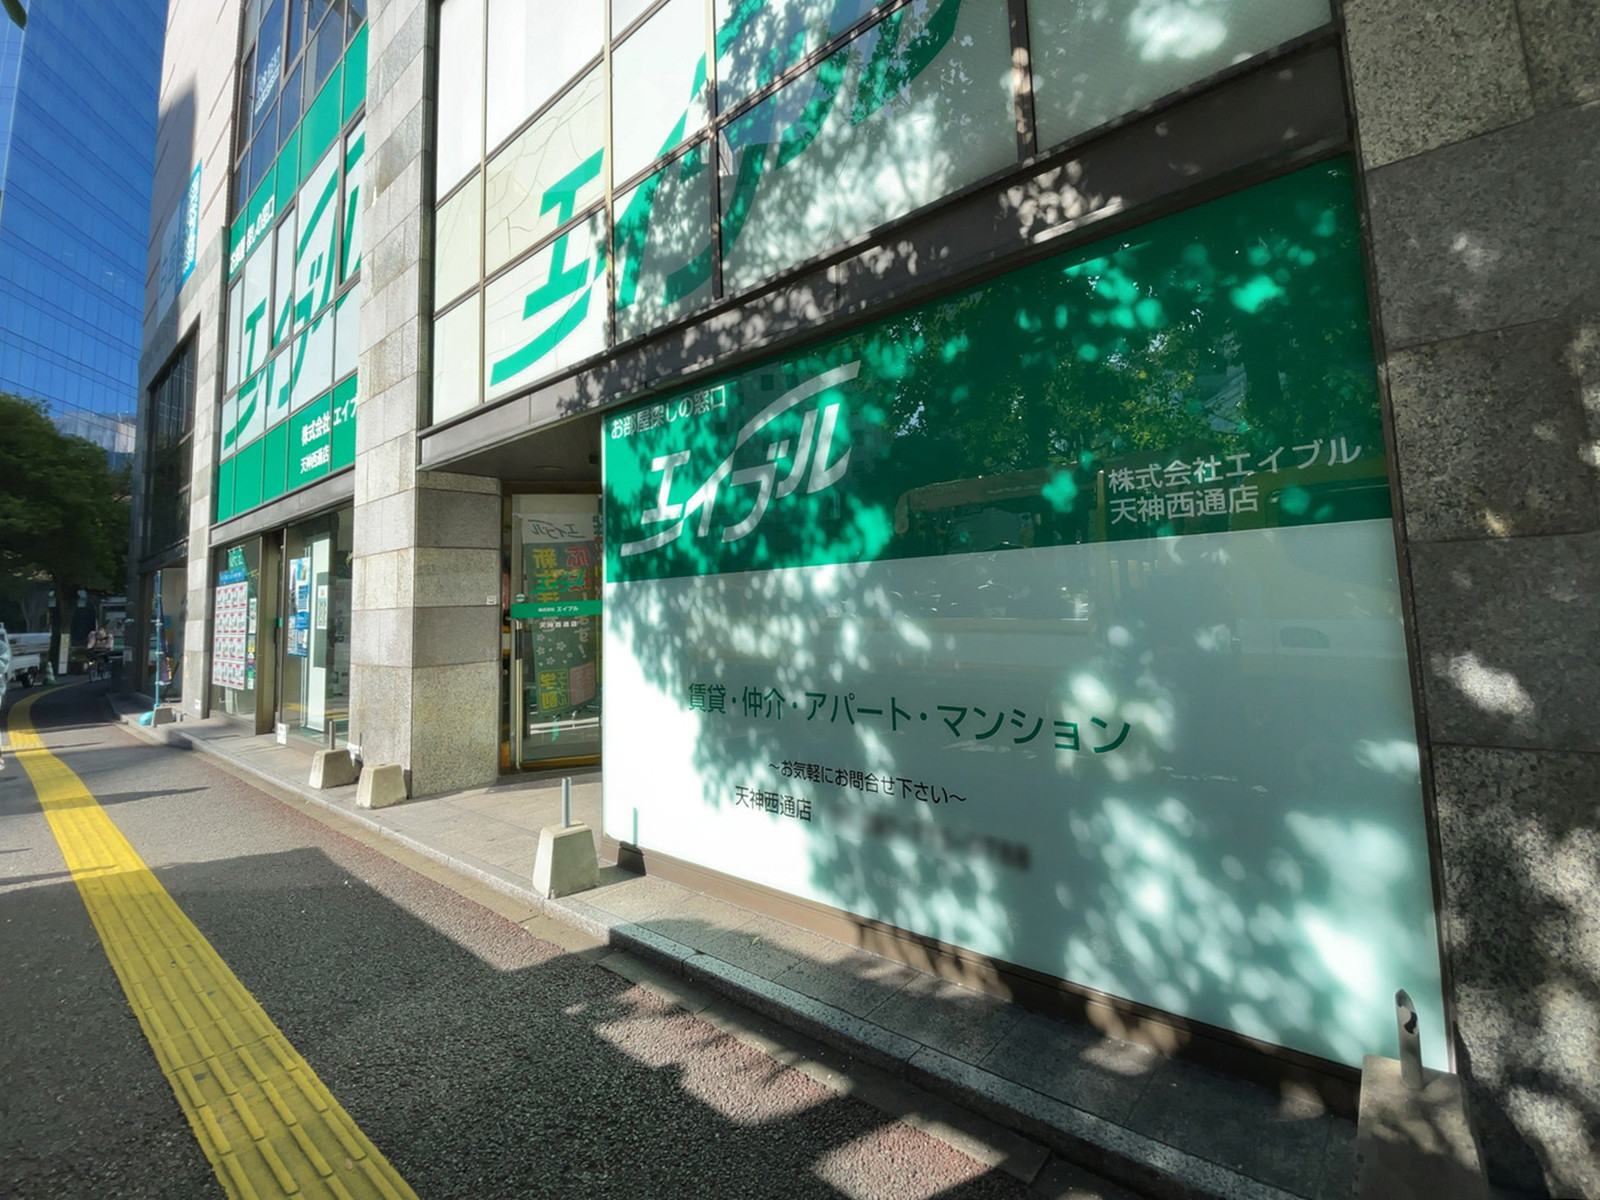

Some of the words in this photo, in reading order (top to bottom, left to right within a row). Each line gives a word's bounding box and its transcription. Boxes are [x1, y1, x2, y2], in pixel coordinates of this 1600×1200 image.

[610, 385, 727, 440] お部屋探しの窓口
[620, 359, 862, 558] エイブル
[1108, 436, 1362, 494] 株式会社エイブル
[1109, 484, 1260, 526] 天神西通店
[688, 683, 1132, 754] 賃貸・仲介・アパート・マンション
[734, 785, 812, 822] 天神西通店
